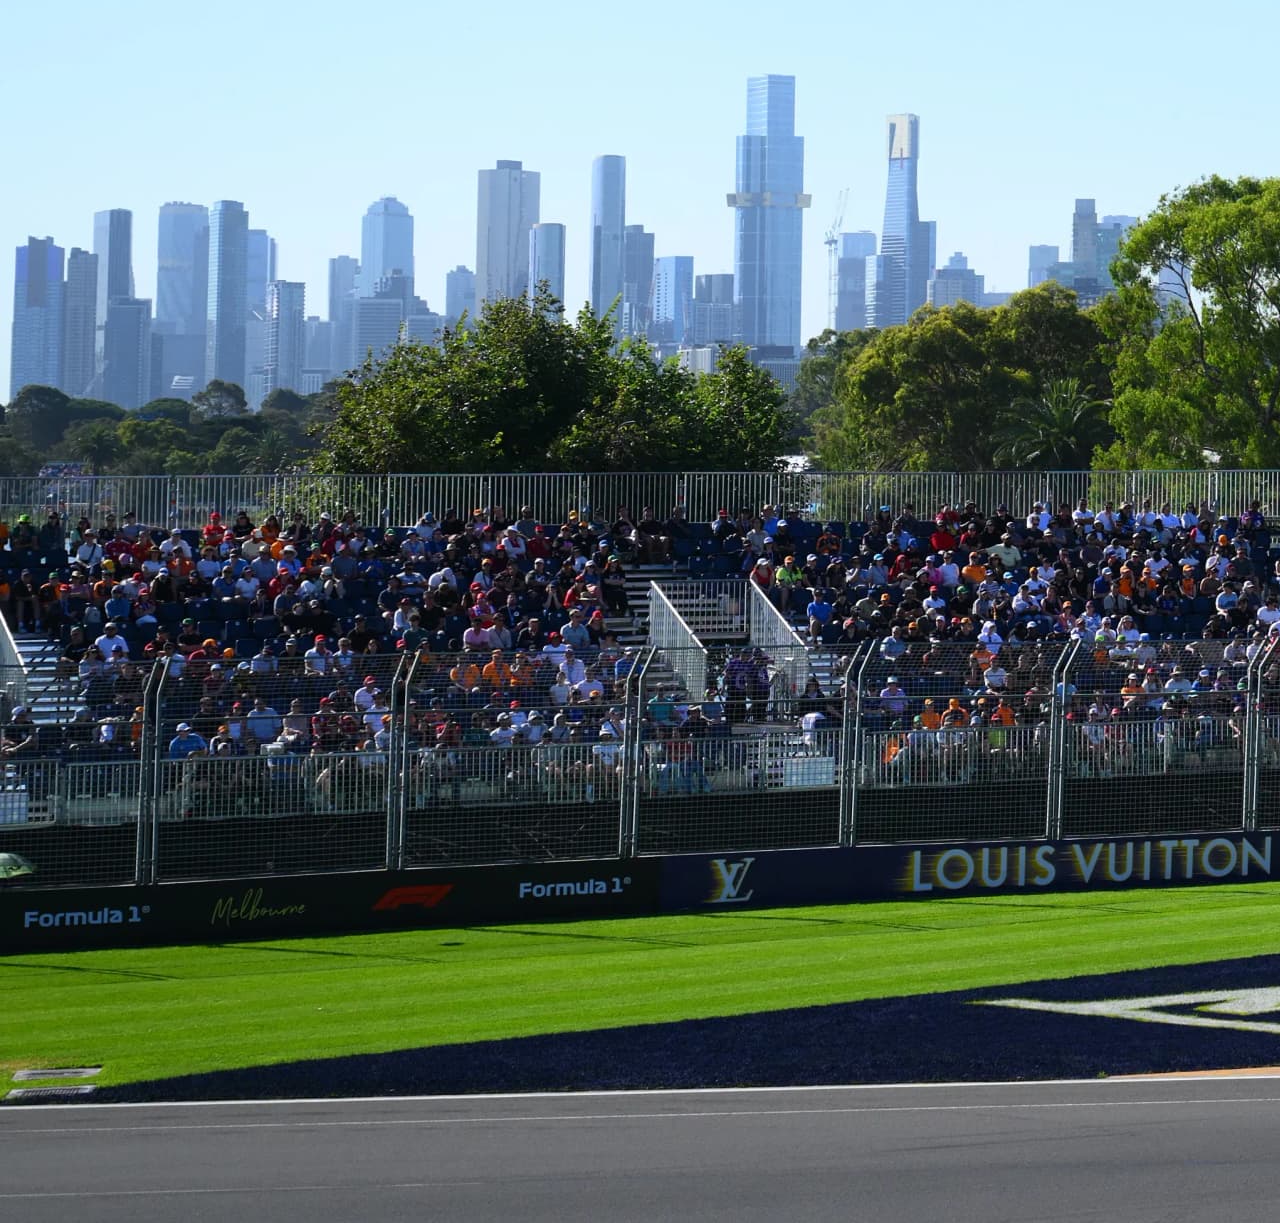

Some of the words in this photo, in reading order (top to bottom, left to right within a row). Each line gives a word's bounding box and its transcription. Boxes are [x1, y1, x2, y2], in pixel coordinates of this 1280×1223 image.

[912, 846, 1055, 893] LOUIS
[1072, 836, 1272, 883] VUITTON
[518, 878, 606, 899] Formula
[24, 907, 123, 927] Formula
[211, 888, 305, 925] Melbourne
